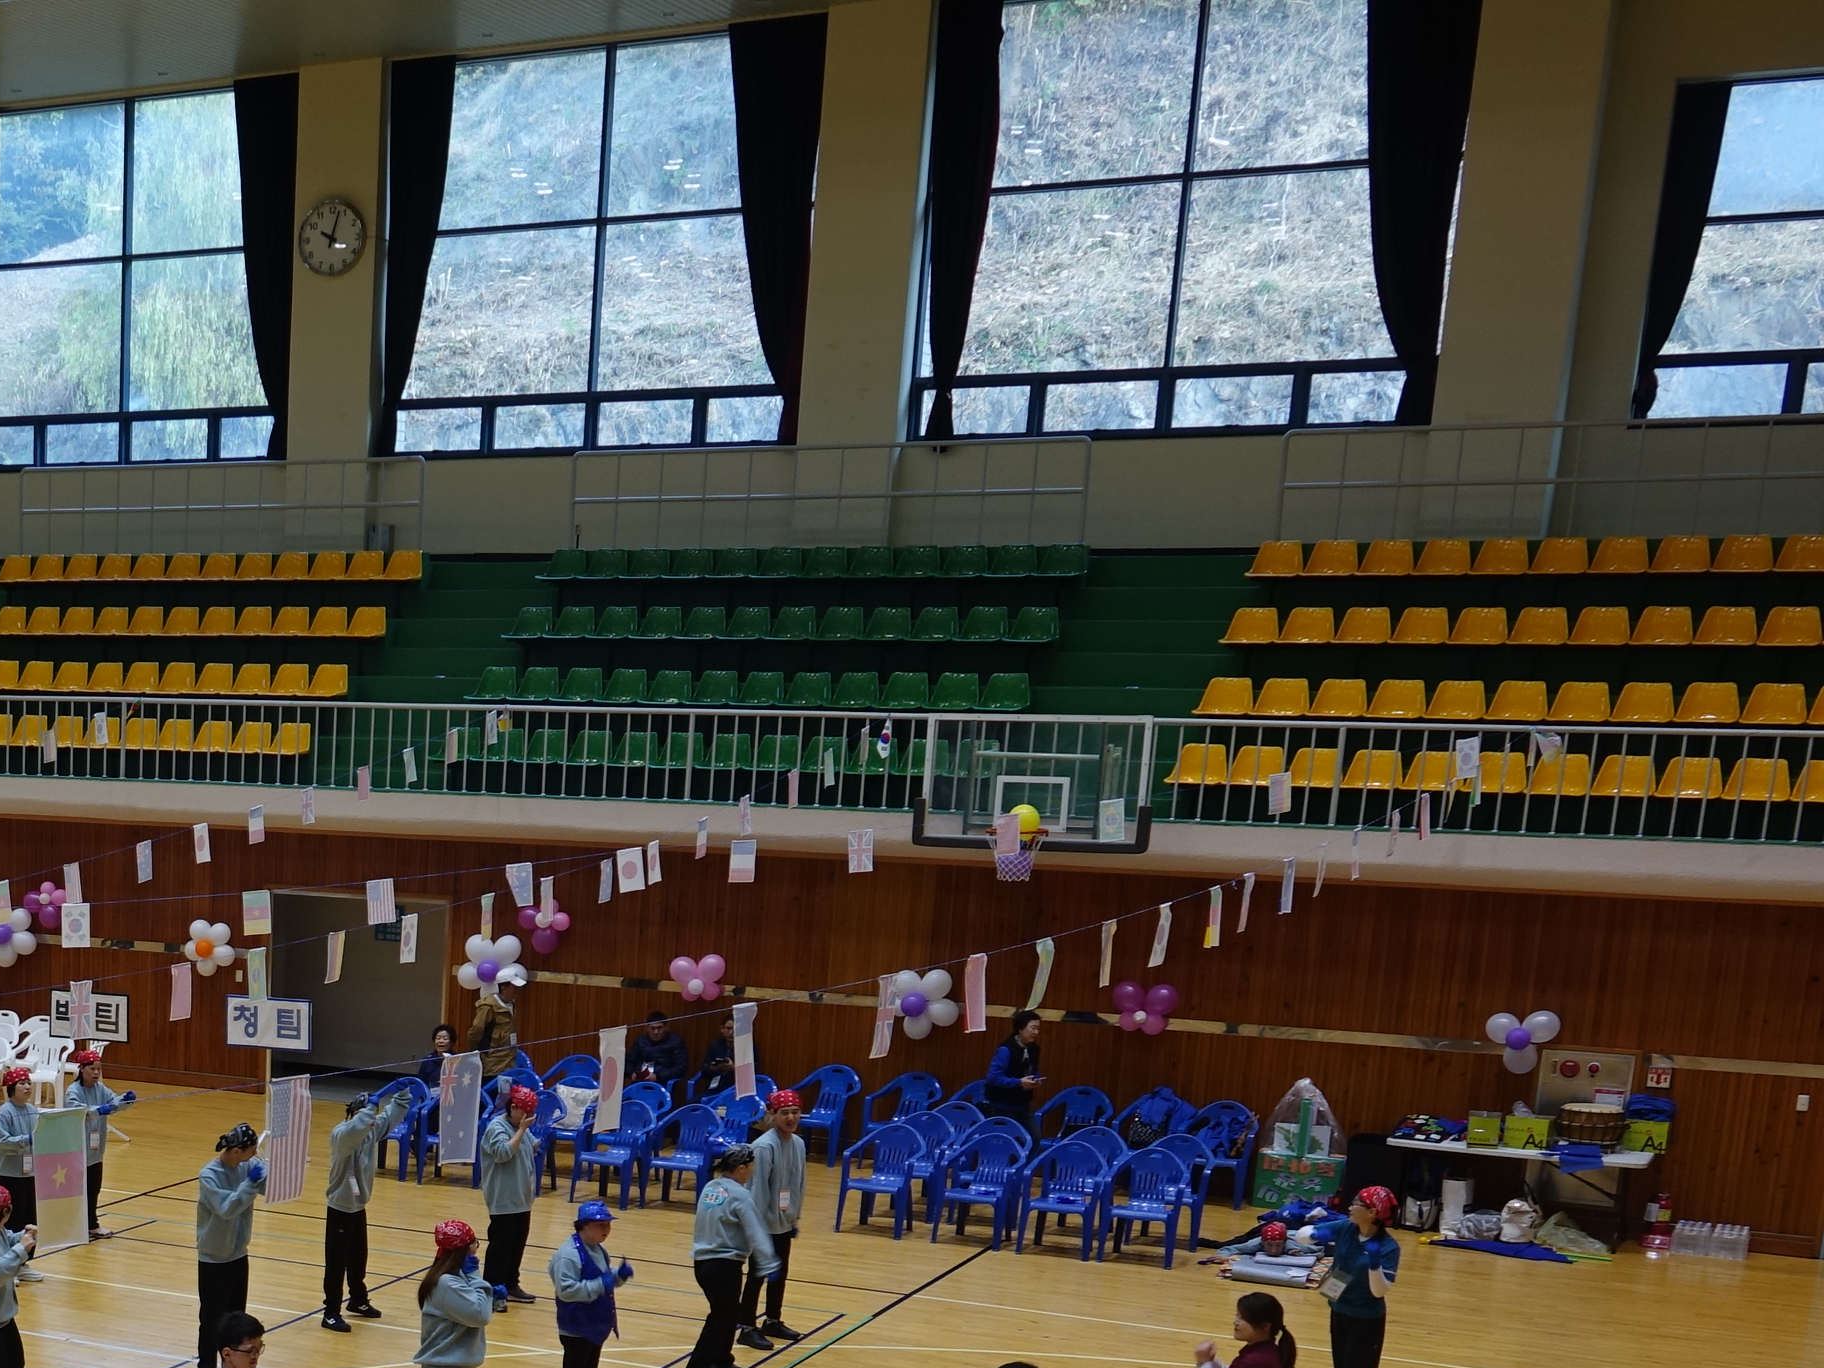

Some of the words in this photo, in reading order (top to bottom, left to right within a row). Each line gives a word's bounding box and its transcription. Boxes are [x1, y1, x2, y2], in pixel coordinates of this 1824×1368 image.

[329, 206, 337, 214] 12
[317, 211, 324, 219] 11
[309, 222, 318, 230] 10
[351, 219, 357, 227] 2
[1521, 1133, 1547, 1150] A4
[1640, 1135, 1667, 1154] A4
